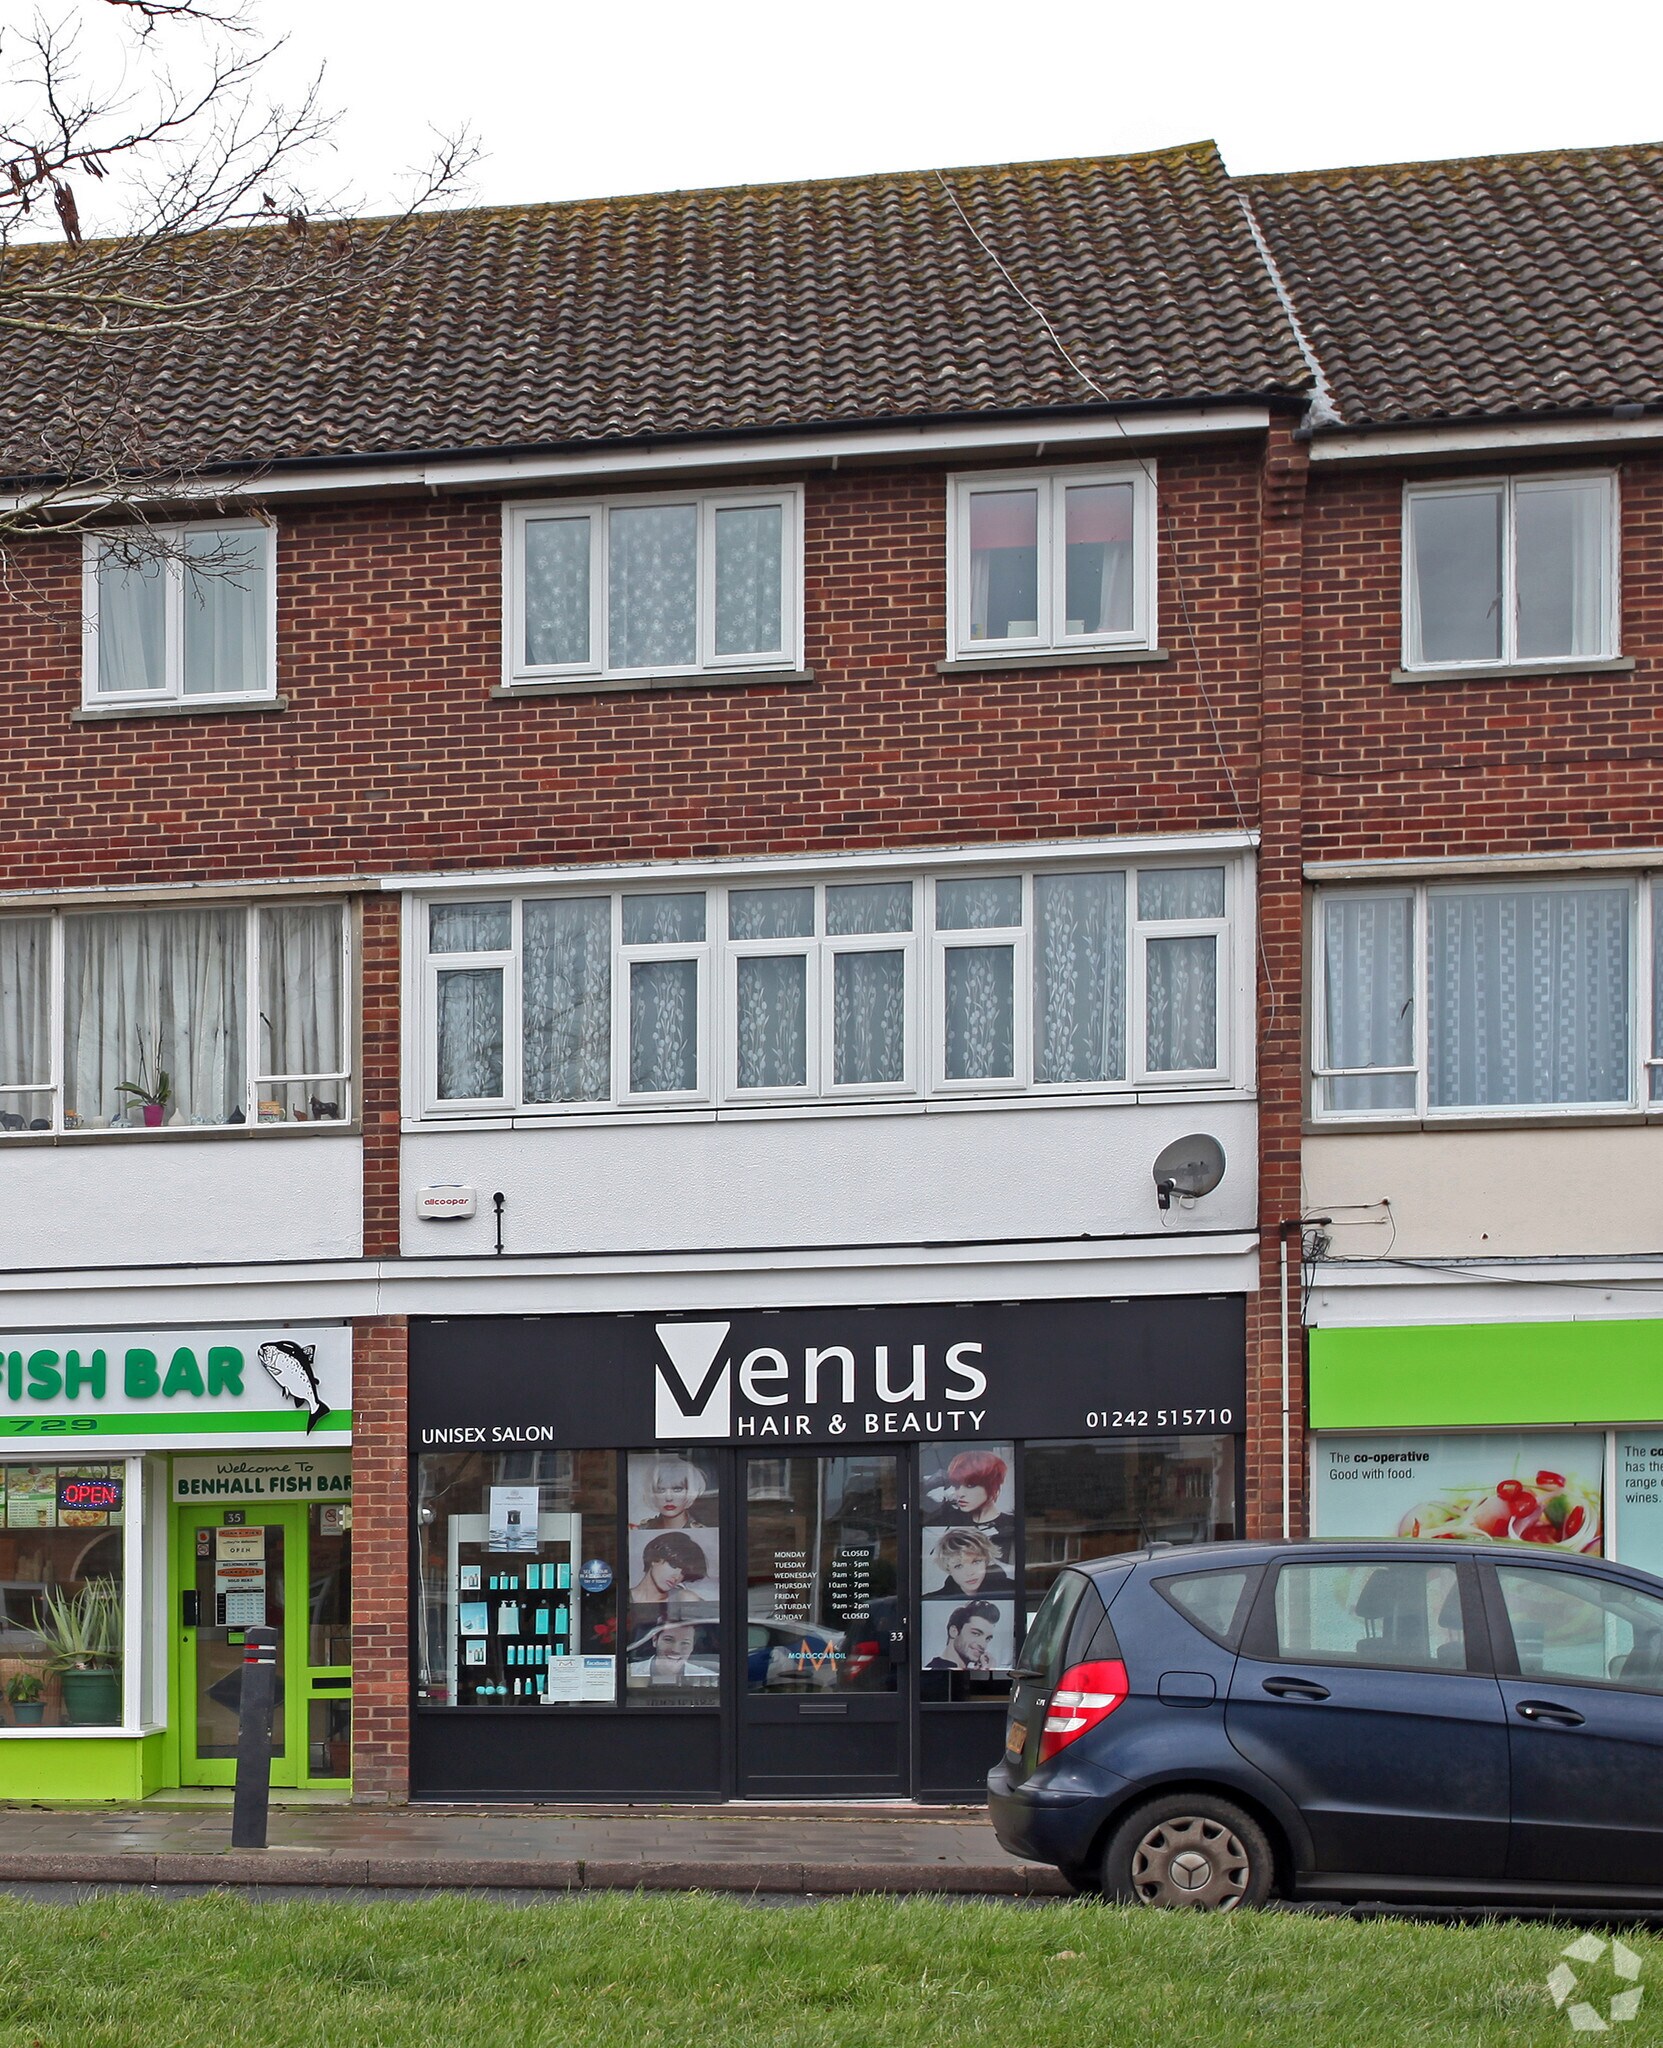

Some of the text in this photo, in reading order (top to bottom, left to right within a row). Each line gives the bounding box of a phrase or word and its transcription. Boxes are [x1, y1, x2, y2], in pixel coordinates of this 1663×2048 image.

[424, 1198, 469, 1206] allcooper
[124, 1346, 244, 1398] BAR
[655, 1321, 988, 1439] Venus
[737, 1410, 986, 1436] HAIR & BEAUTY
[1086, 1408, 1232, 1428] 01242 515710
[9, 1419, 98, 1432] 729
[422, 1426, 554, 1444] UNISEX SALON
[1330, 1451, 1429, 1464] The co-operative
[1624, 1445, 1646, 1457] The
[217, 1462, 314, 1474] Welcome To
[1625, 1461, 1646, 1472] has
[1329, 1467, 1415, 1480] Good with food.
[178, 1475, 351, 1495] BENHALL FISH BAR
[1625, 1478, 1657, 1490] range
[65, 1485, 115, 1504] OPEN
[1625, 1492, 1661, 1503] wines.
[227, 1513, 241, 1523] 35
[890, 1632, 903, 1641] 33
